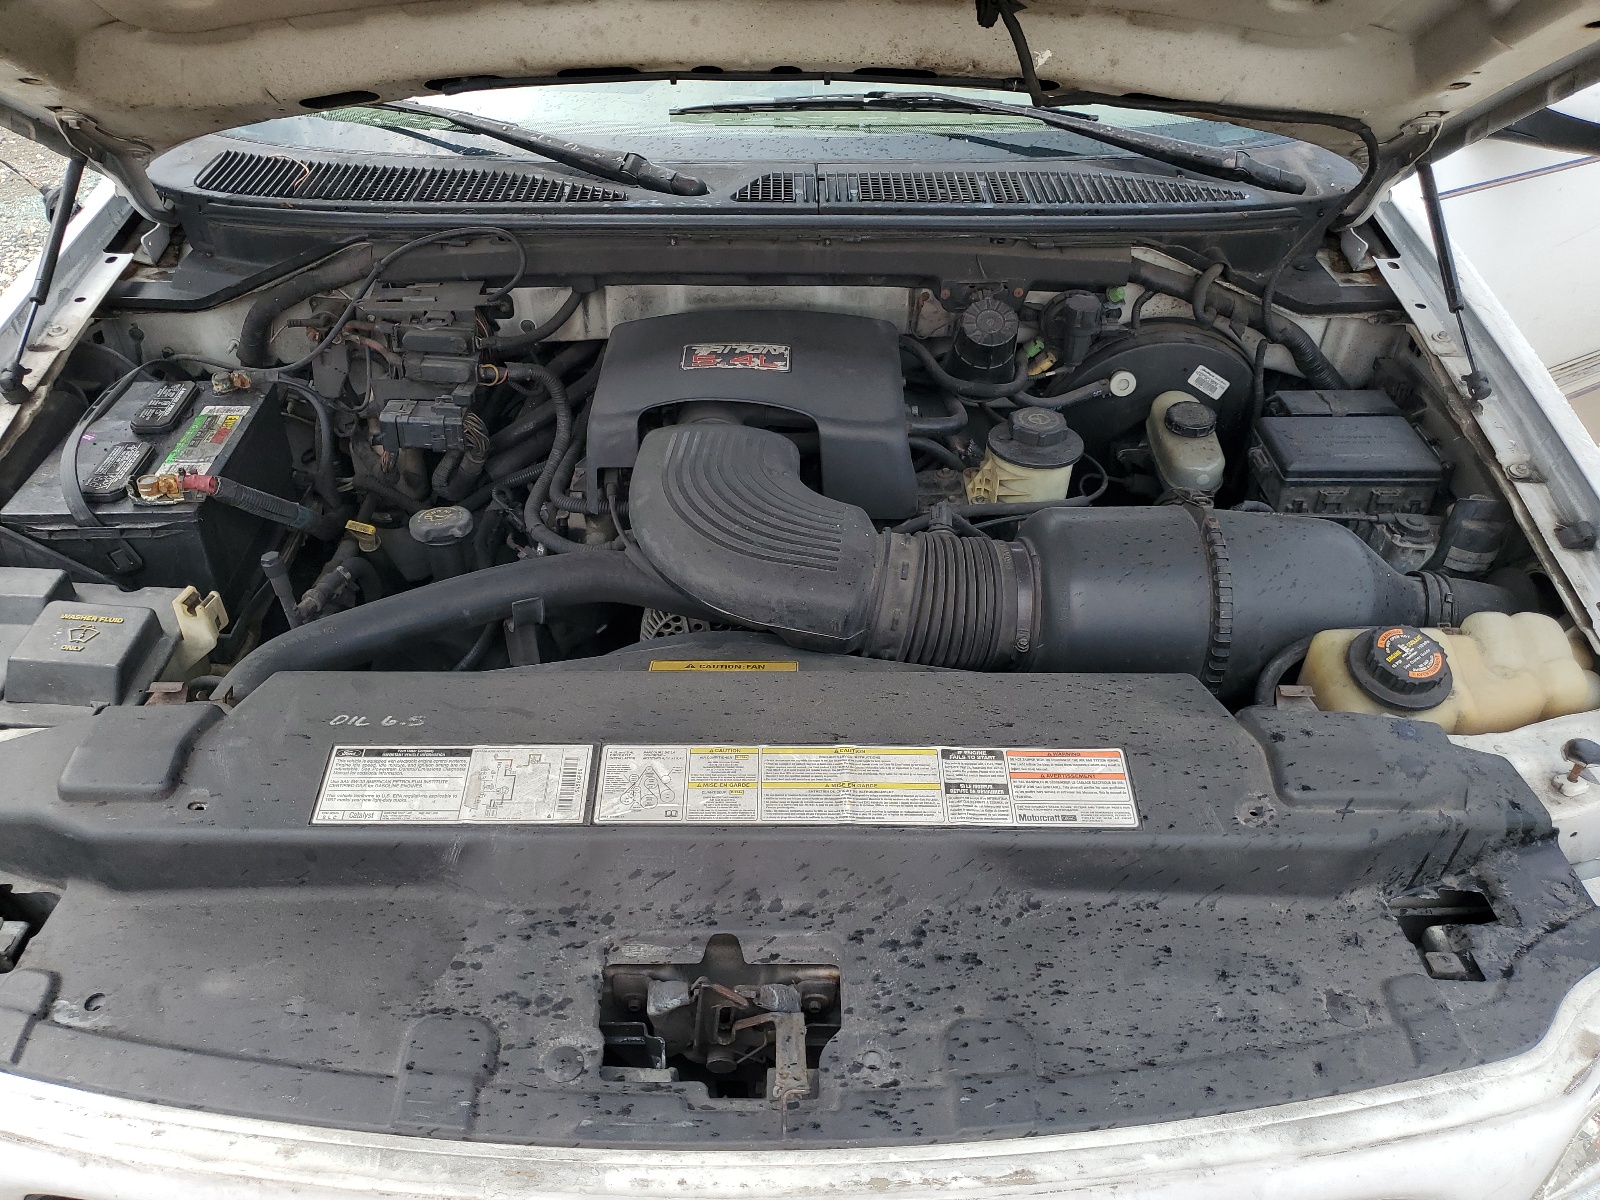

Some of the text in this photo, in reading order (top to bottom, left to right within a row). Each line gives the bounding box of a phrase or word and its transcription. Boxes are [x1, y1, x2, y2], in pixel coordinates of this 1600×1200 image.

[691, 354, 780, 368] 5.4L
[60, 613, 125, 624] WASHER FLUID
[60, 644, 85, 652] ONLY
[329, 714, 427, 727] OIL 6.5
[1018, 813, 1061, 822] Motorcraft
